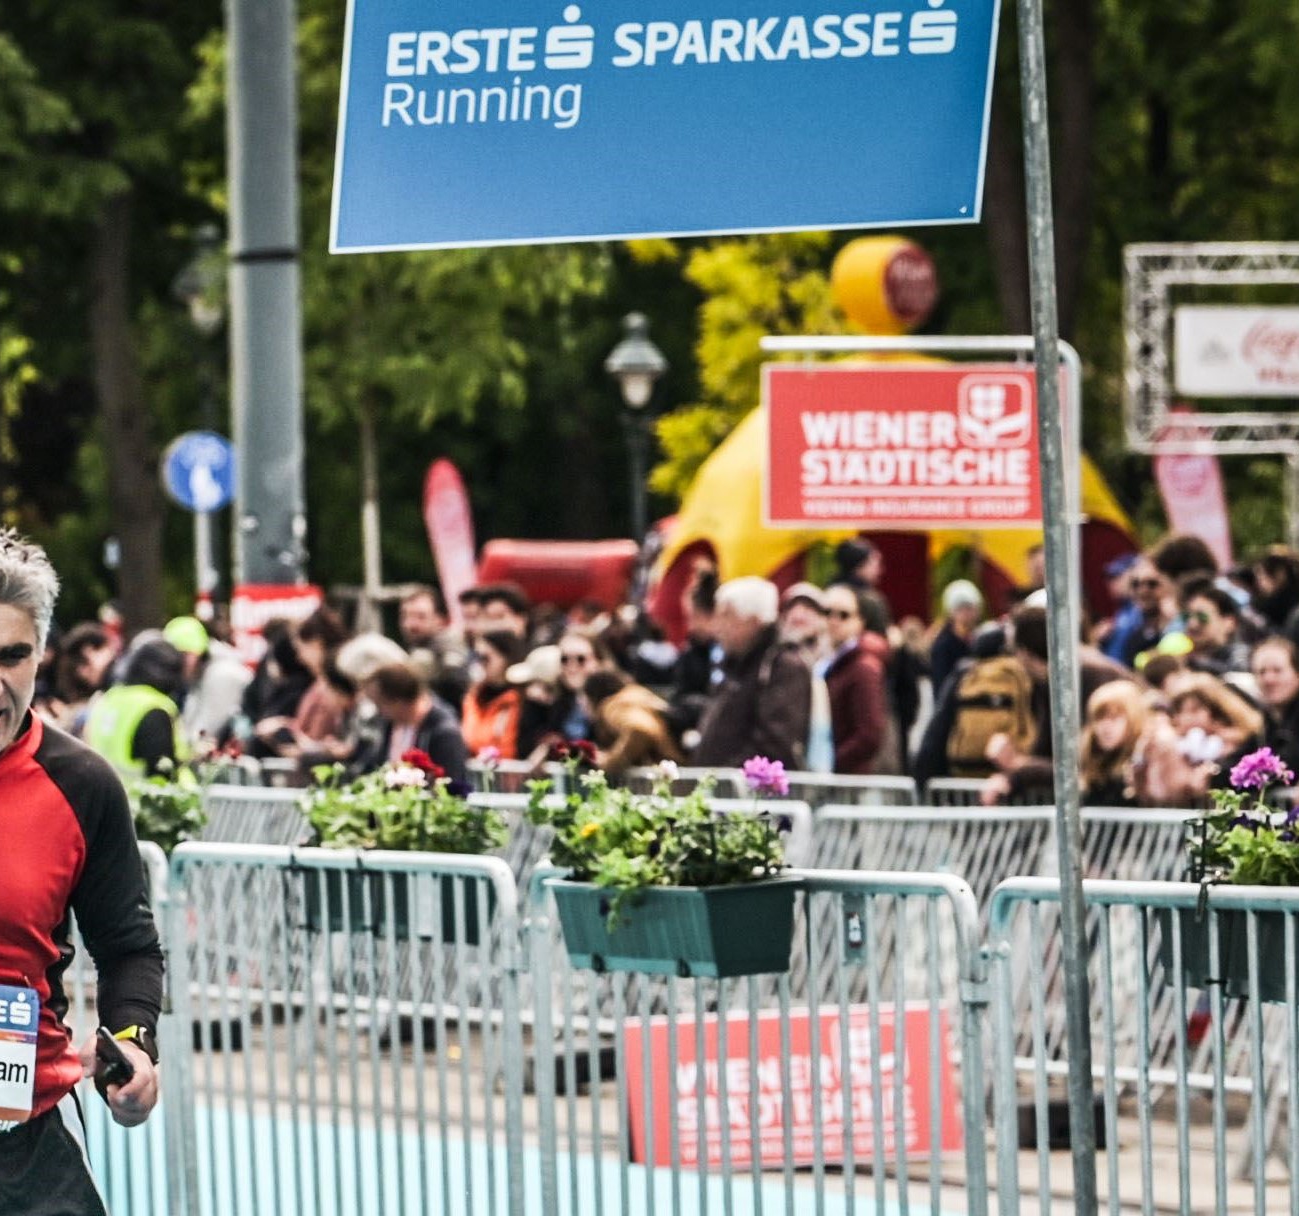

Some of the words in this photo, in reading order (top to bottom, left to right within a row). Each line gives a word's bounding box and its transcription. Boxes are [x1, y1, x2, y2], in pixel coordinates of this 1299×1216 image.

[386, 27, 538, 77] ERSTE
[612, 12, 902, 67] SPARKASSE
[381, 75, 583, 129] Running
[801, 411, 958, 448] WIENER
